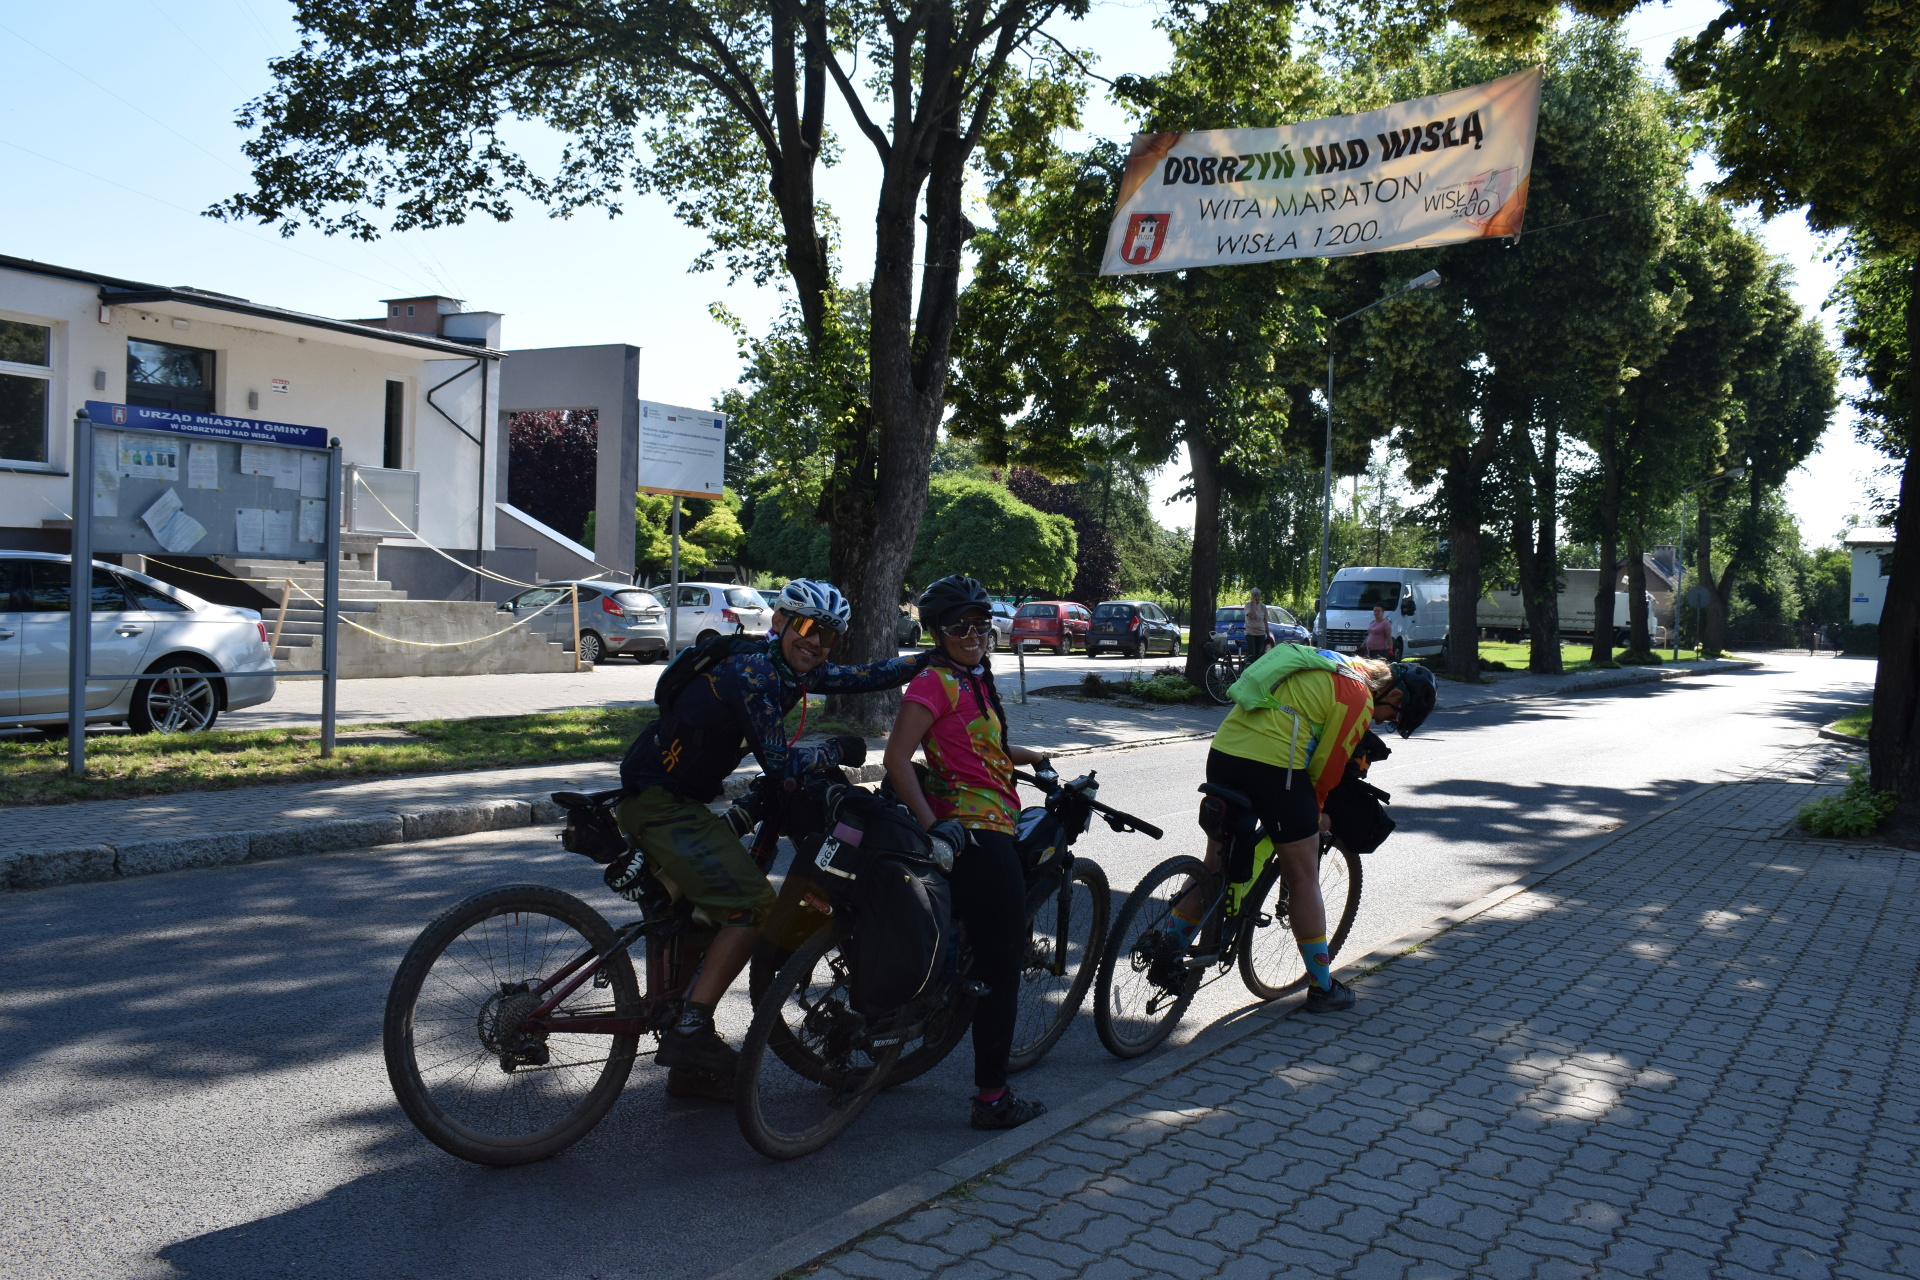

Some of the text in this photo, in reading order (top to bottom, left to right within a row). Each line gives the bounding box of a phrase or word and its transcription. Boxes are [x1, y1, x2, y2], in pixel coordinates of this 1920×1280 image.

[1162, 109, 1484, 186] DOBRZYŃ NAD WISŁĄ
[1199, 171, 1424, 221] WITA MARATON
[1424, 188, 1479, 213] WISŁA
[1217, 219, 1383, 256] WISŁA 1200.
[139, 409, 309, 436] URZĄD MIASTA I GMINY
[180, 425, 230, 436] DOBRZYNIU
[232, 430, 250, 438] NAD
[251, 432, 276, 441] WISŁĄ
[810, 610, 842, 627] 298
